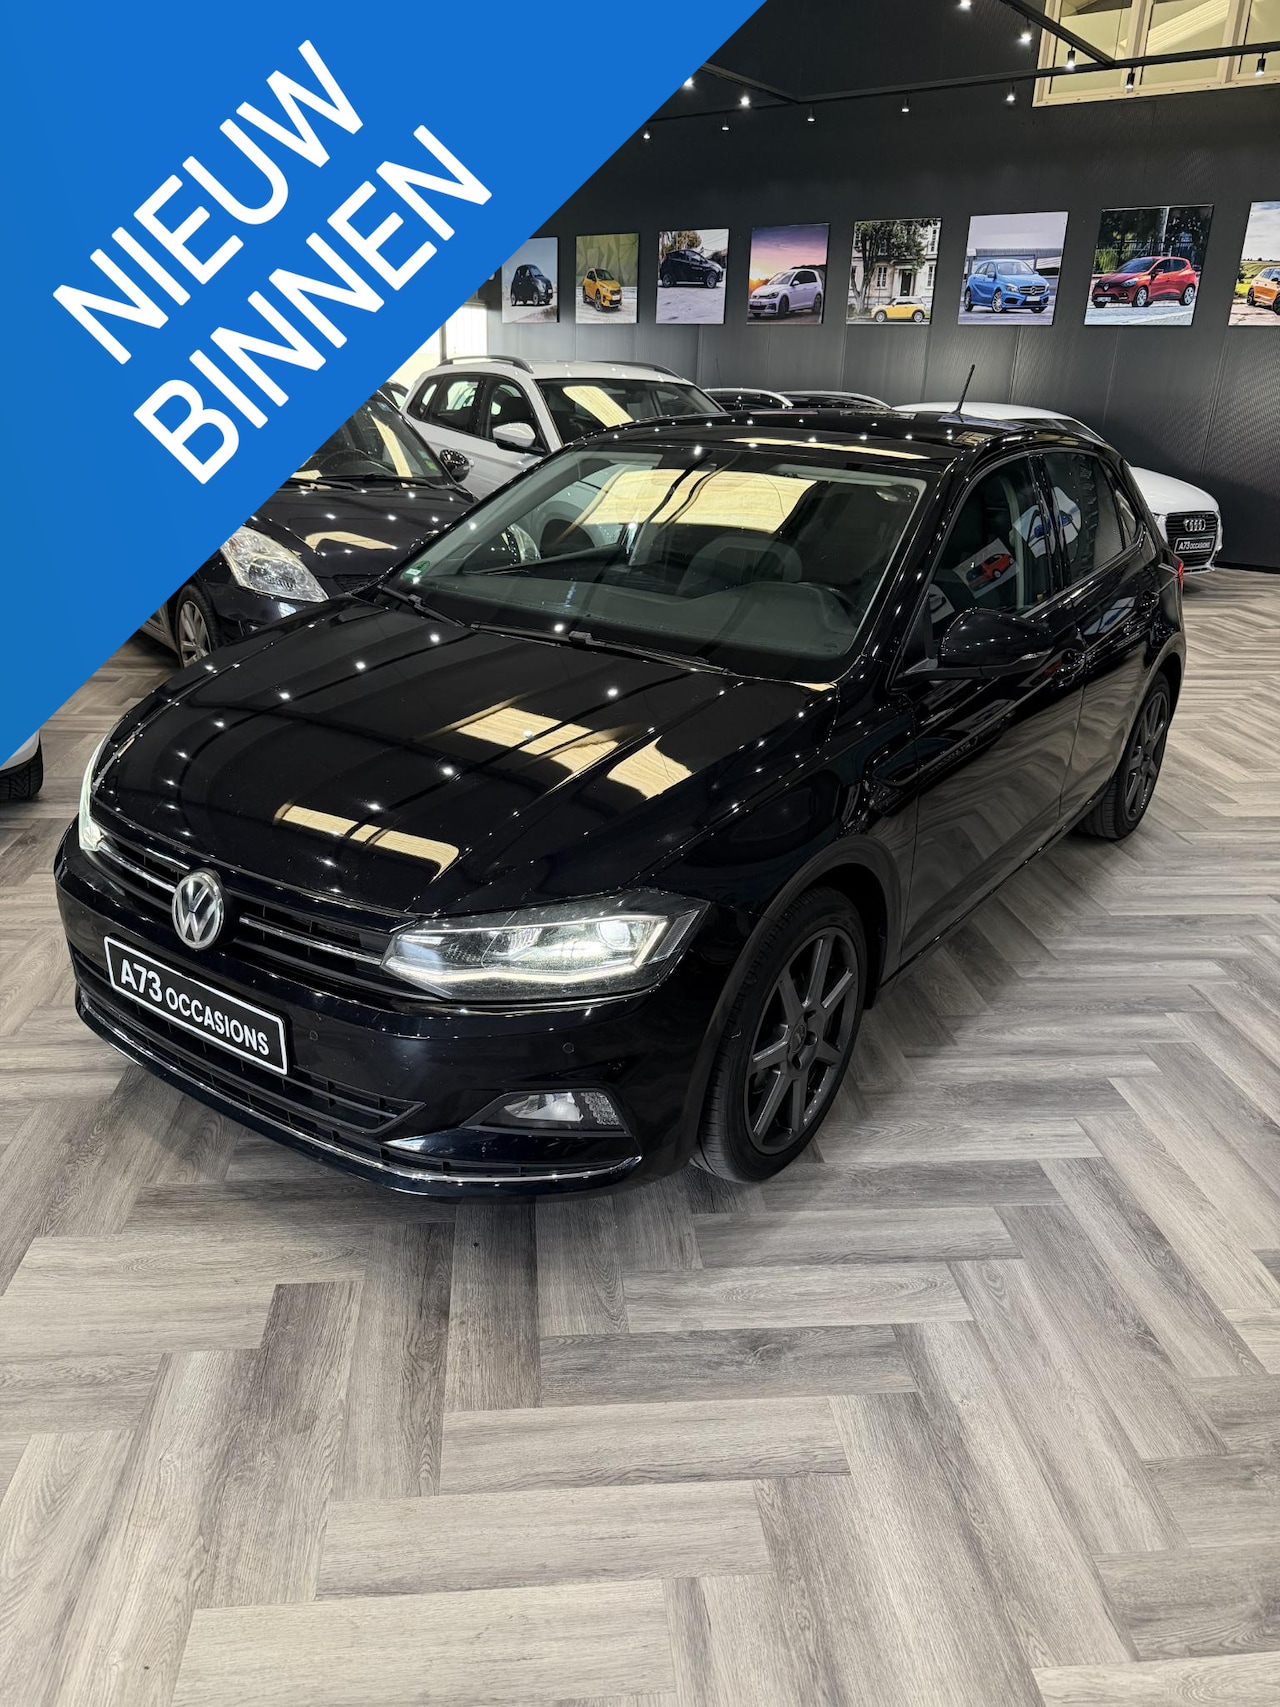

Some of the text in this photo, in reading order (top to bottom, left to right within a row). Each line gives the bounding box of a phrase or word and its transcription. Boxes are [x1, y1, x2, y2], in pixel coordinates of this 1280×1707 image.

[1178, 541, 1190, 551] A73
[121, 959, 270, 1056] A73 OCCASIONS
